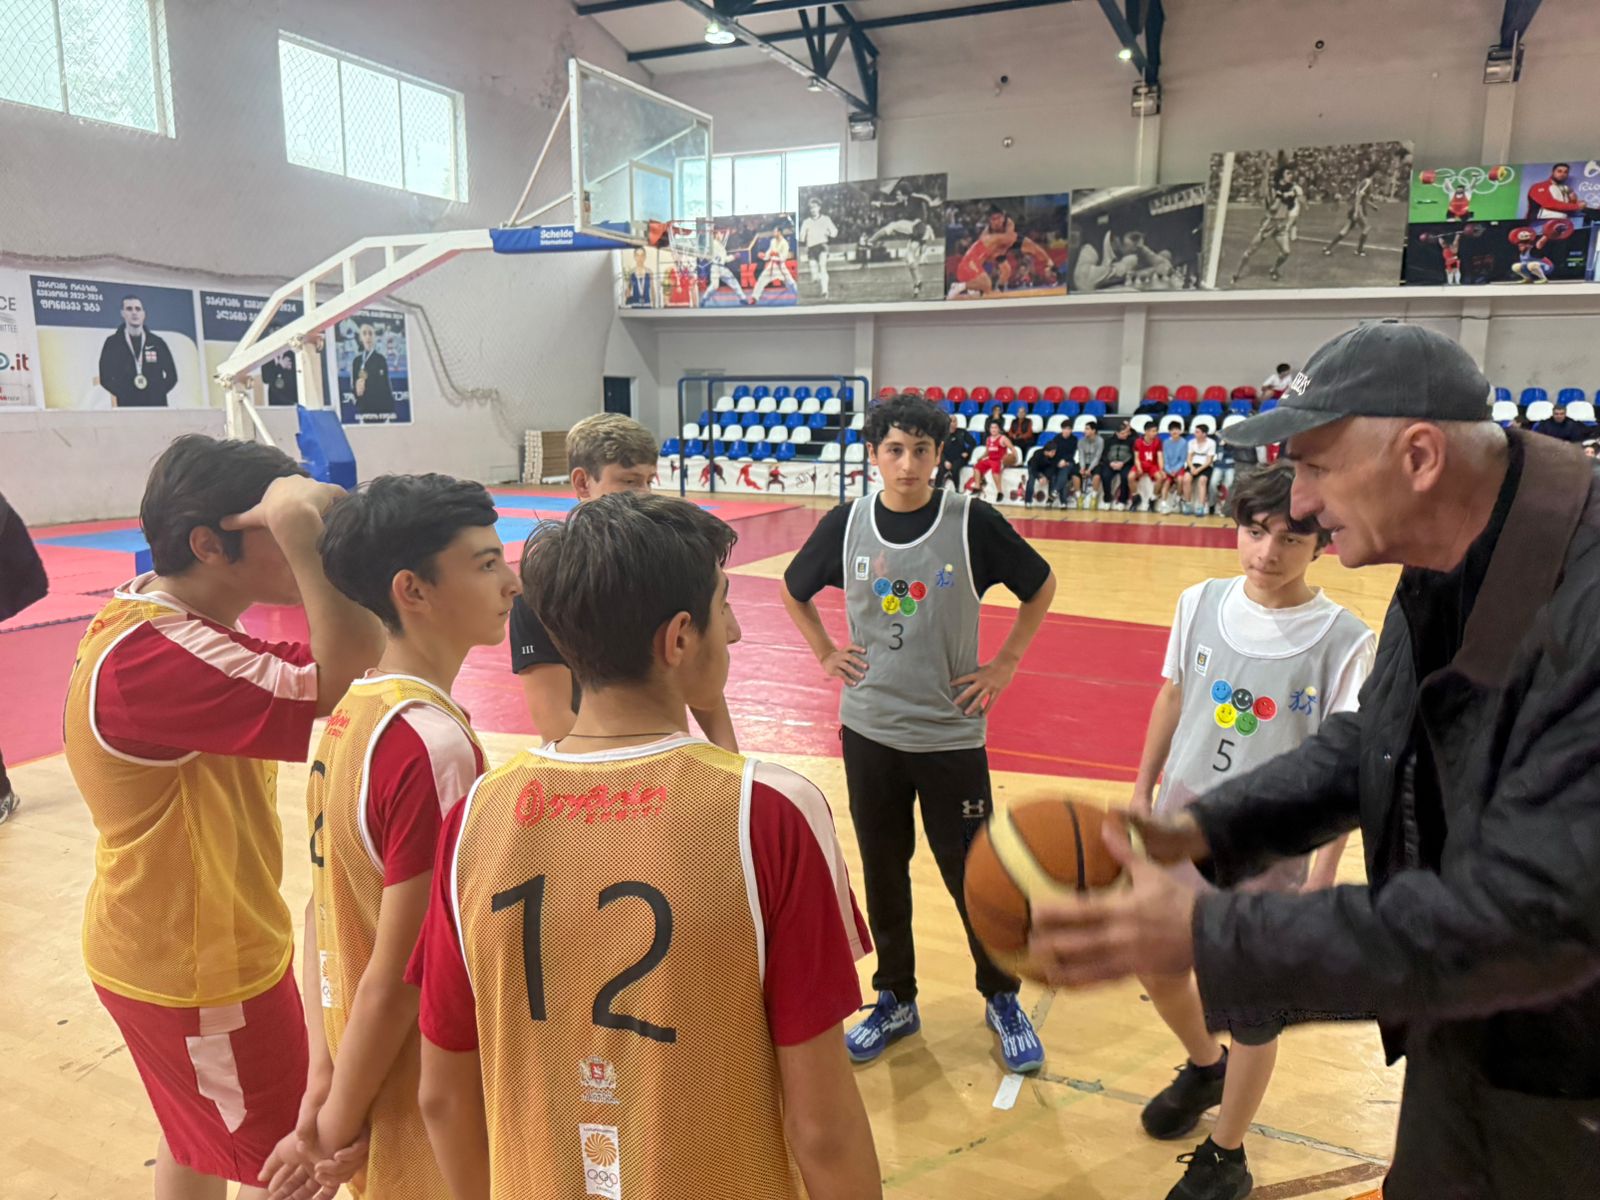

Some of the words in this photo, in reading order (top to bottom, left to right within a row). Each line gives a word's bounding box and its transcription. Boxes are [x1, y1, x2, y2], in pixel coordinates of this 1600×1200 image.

[888, 623, 905, 651] 3
[1212, 738, 1235, 772] 5
[491, 874, 677, 1043] 12
